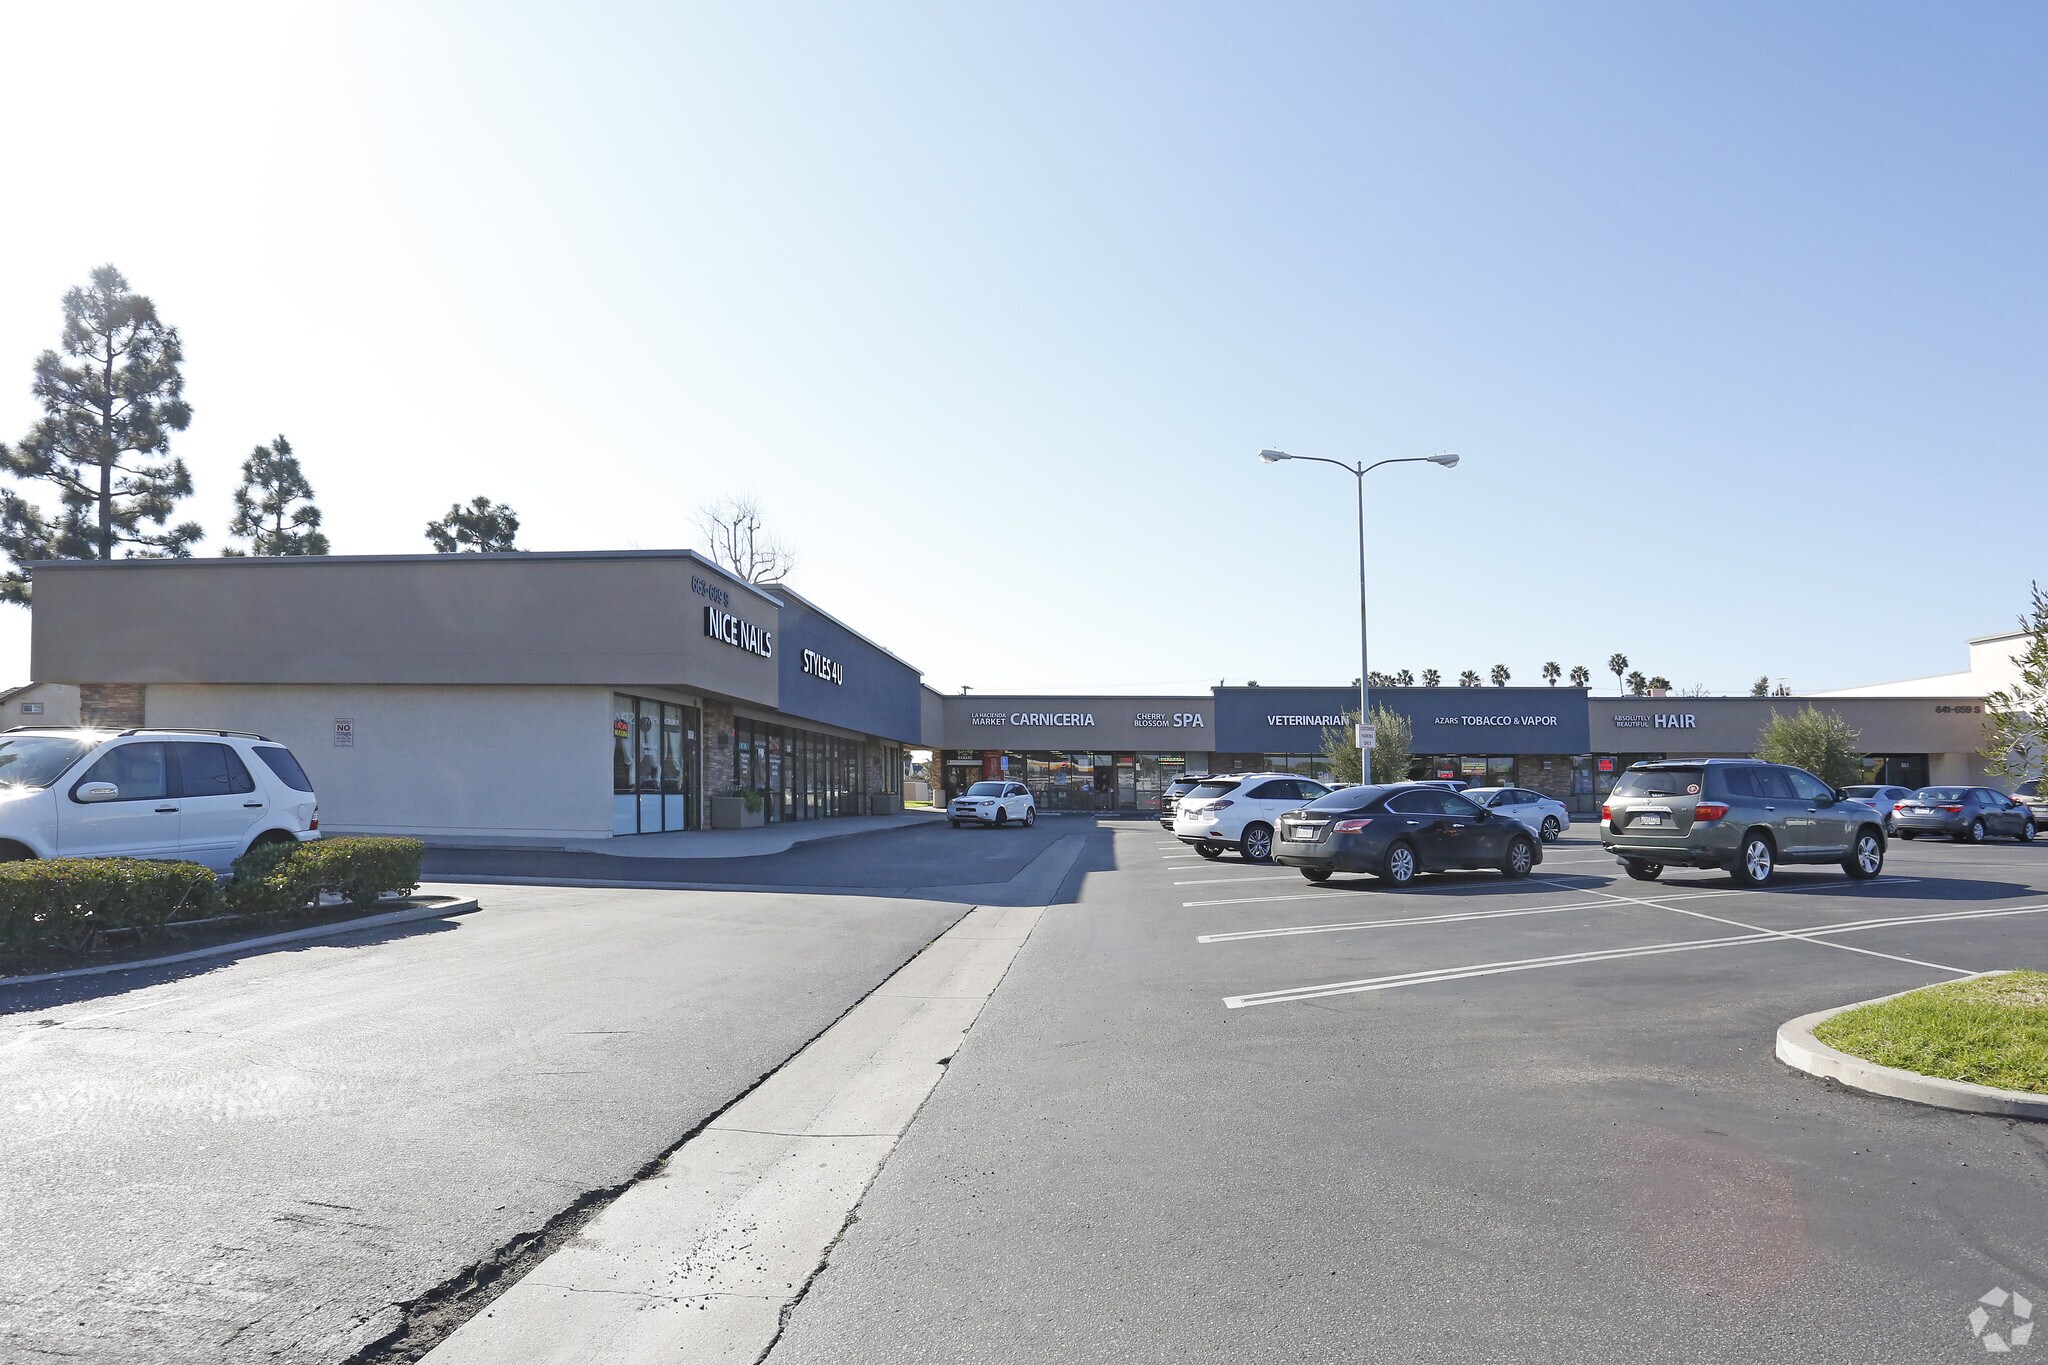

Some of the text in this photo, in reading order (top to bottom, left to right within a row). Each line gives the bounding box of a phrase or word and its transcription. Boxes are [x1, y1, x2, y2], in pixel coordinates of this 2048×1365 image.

[708, 606, 772, 658] NICE NAILS
[803, 648, 830, 680] STYLES
[1010, 712, 1095, 726] CARNICERIA
[1173, 713, 1204, 728] SPA
[1267, 716, 1350, 726] VETERINARIAN
[1461, 716, 1512, 726] TOBACCO
[1520, 716, 1558, 726] VAPOR
[1654, 714, 1696, 728] HAIR
